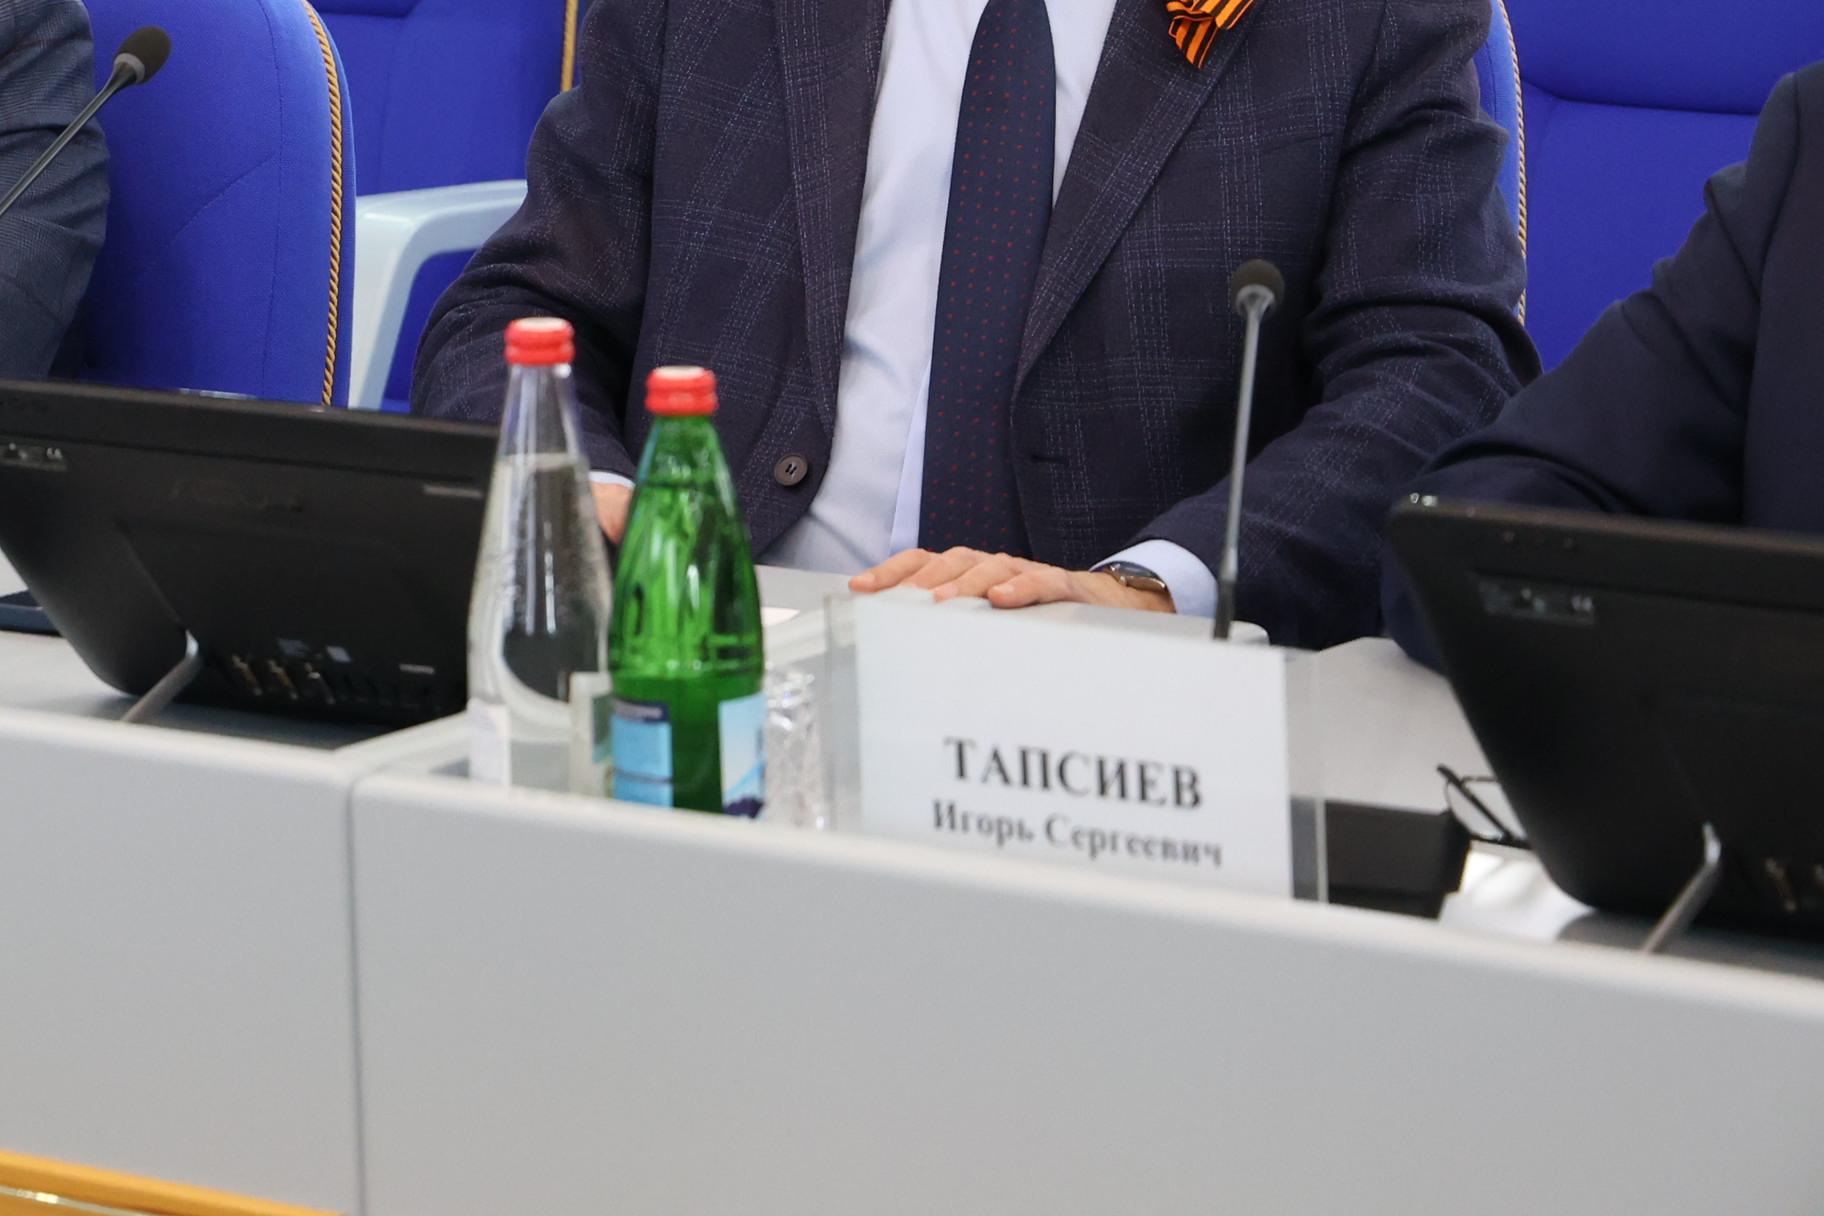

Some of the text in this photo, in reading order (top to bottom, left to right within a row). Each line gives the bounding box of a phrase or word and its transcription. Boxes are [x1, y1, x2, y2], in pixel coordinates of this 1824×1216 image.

[943, 736, 1202, 809] ТАПСИЕВ
[932, 798, 1223, 868] Игорь Сергеевич
